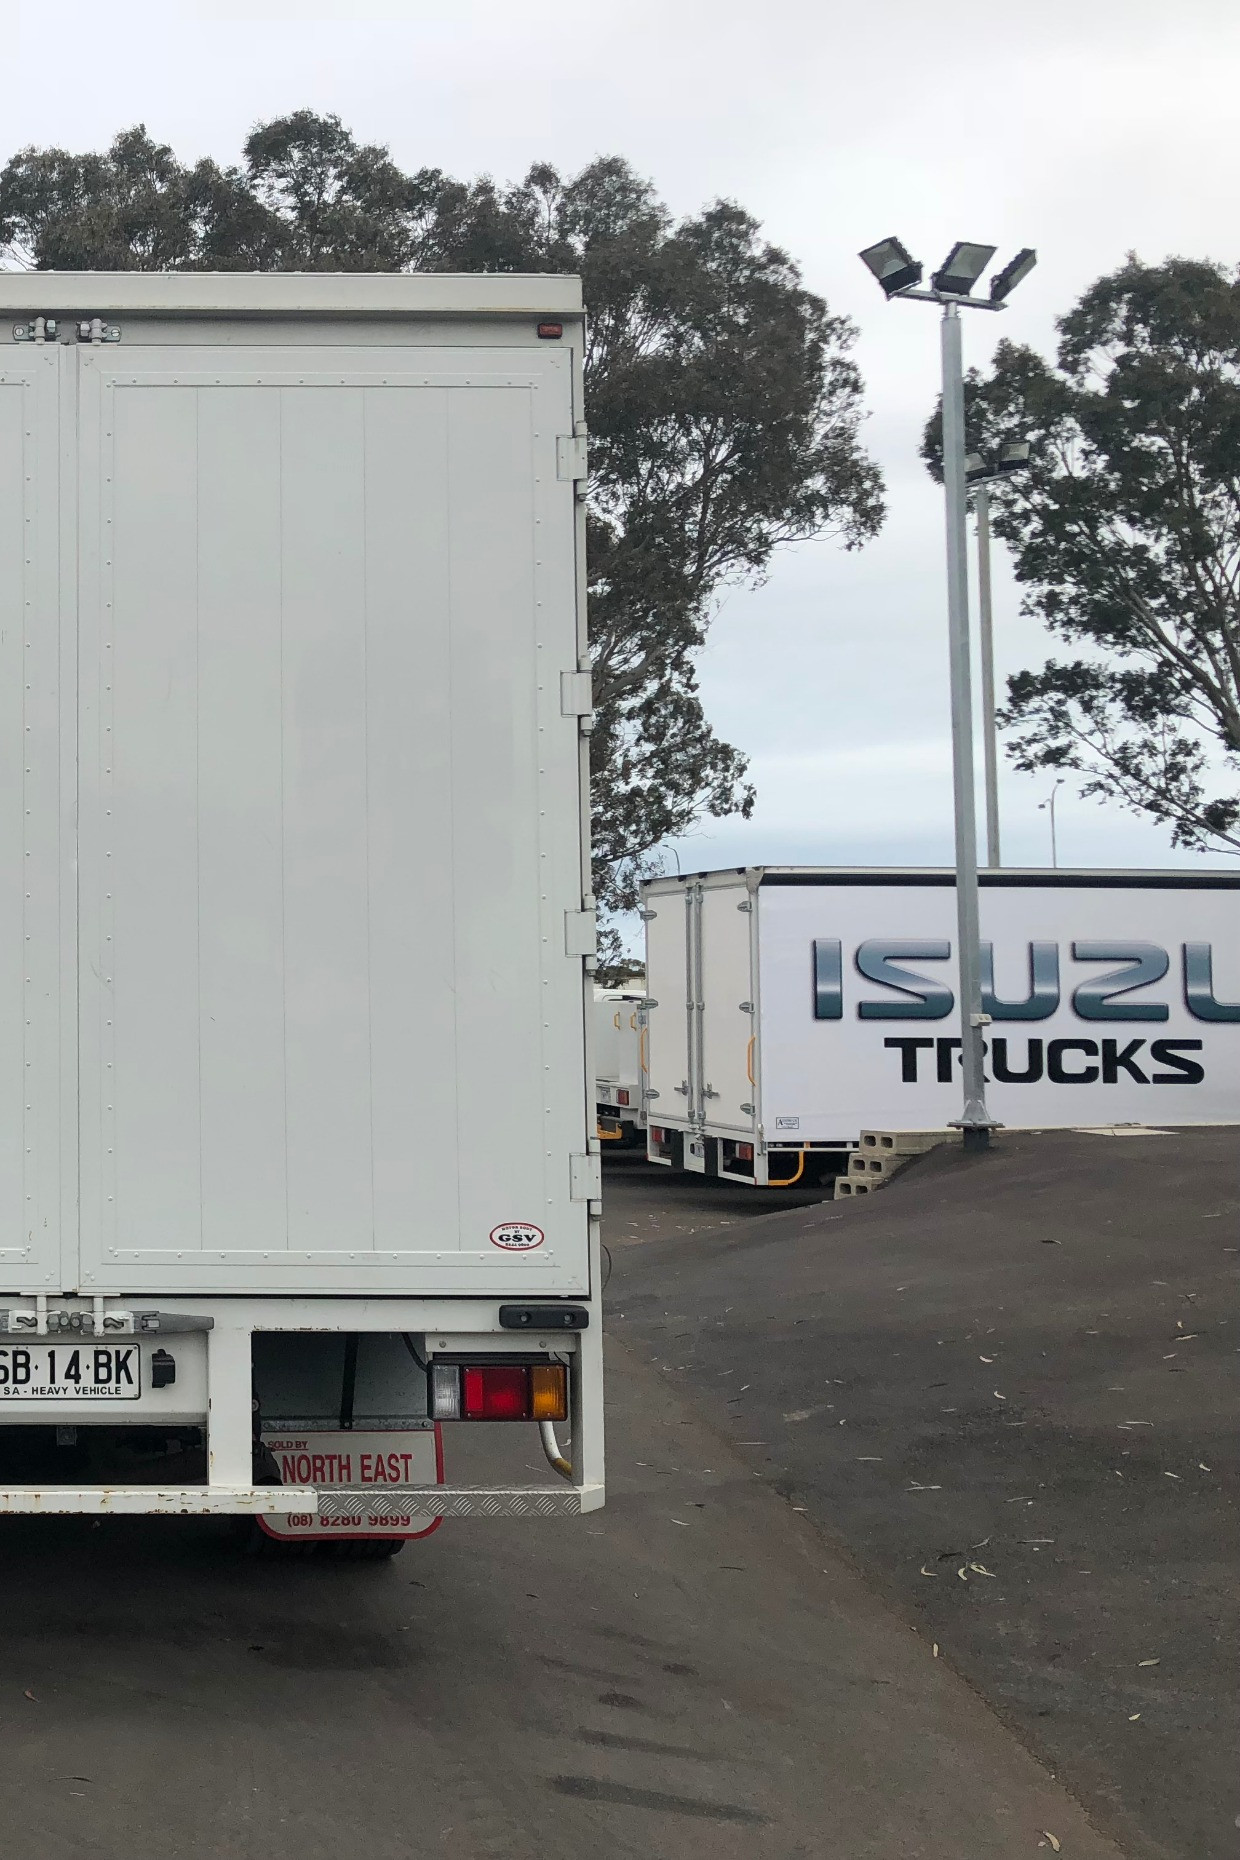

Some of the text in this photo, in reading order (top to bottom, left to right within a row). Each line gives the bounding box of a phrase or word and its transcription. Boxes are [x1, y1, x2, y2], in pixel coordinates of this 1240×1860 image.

[811, 938, 1240, 1022] ISUZU
[884, 1037, 1205, 1085] TRUCKS
[498, 1234, 536, 1242] GSV
[31, 1387, 68, 1395] HEAVY
[75, 1386, 122, 1395] VEHICLE
[268, 1441, 308, 1449] SOLD BY
[282, 1454, 412, 1483] NORTH EAST
[287, 1514, 313, 1527] (08)
